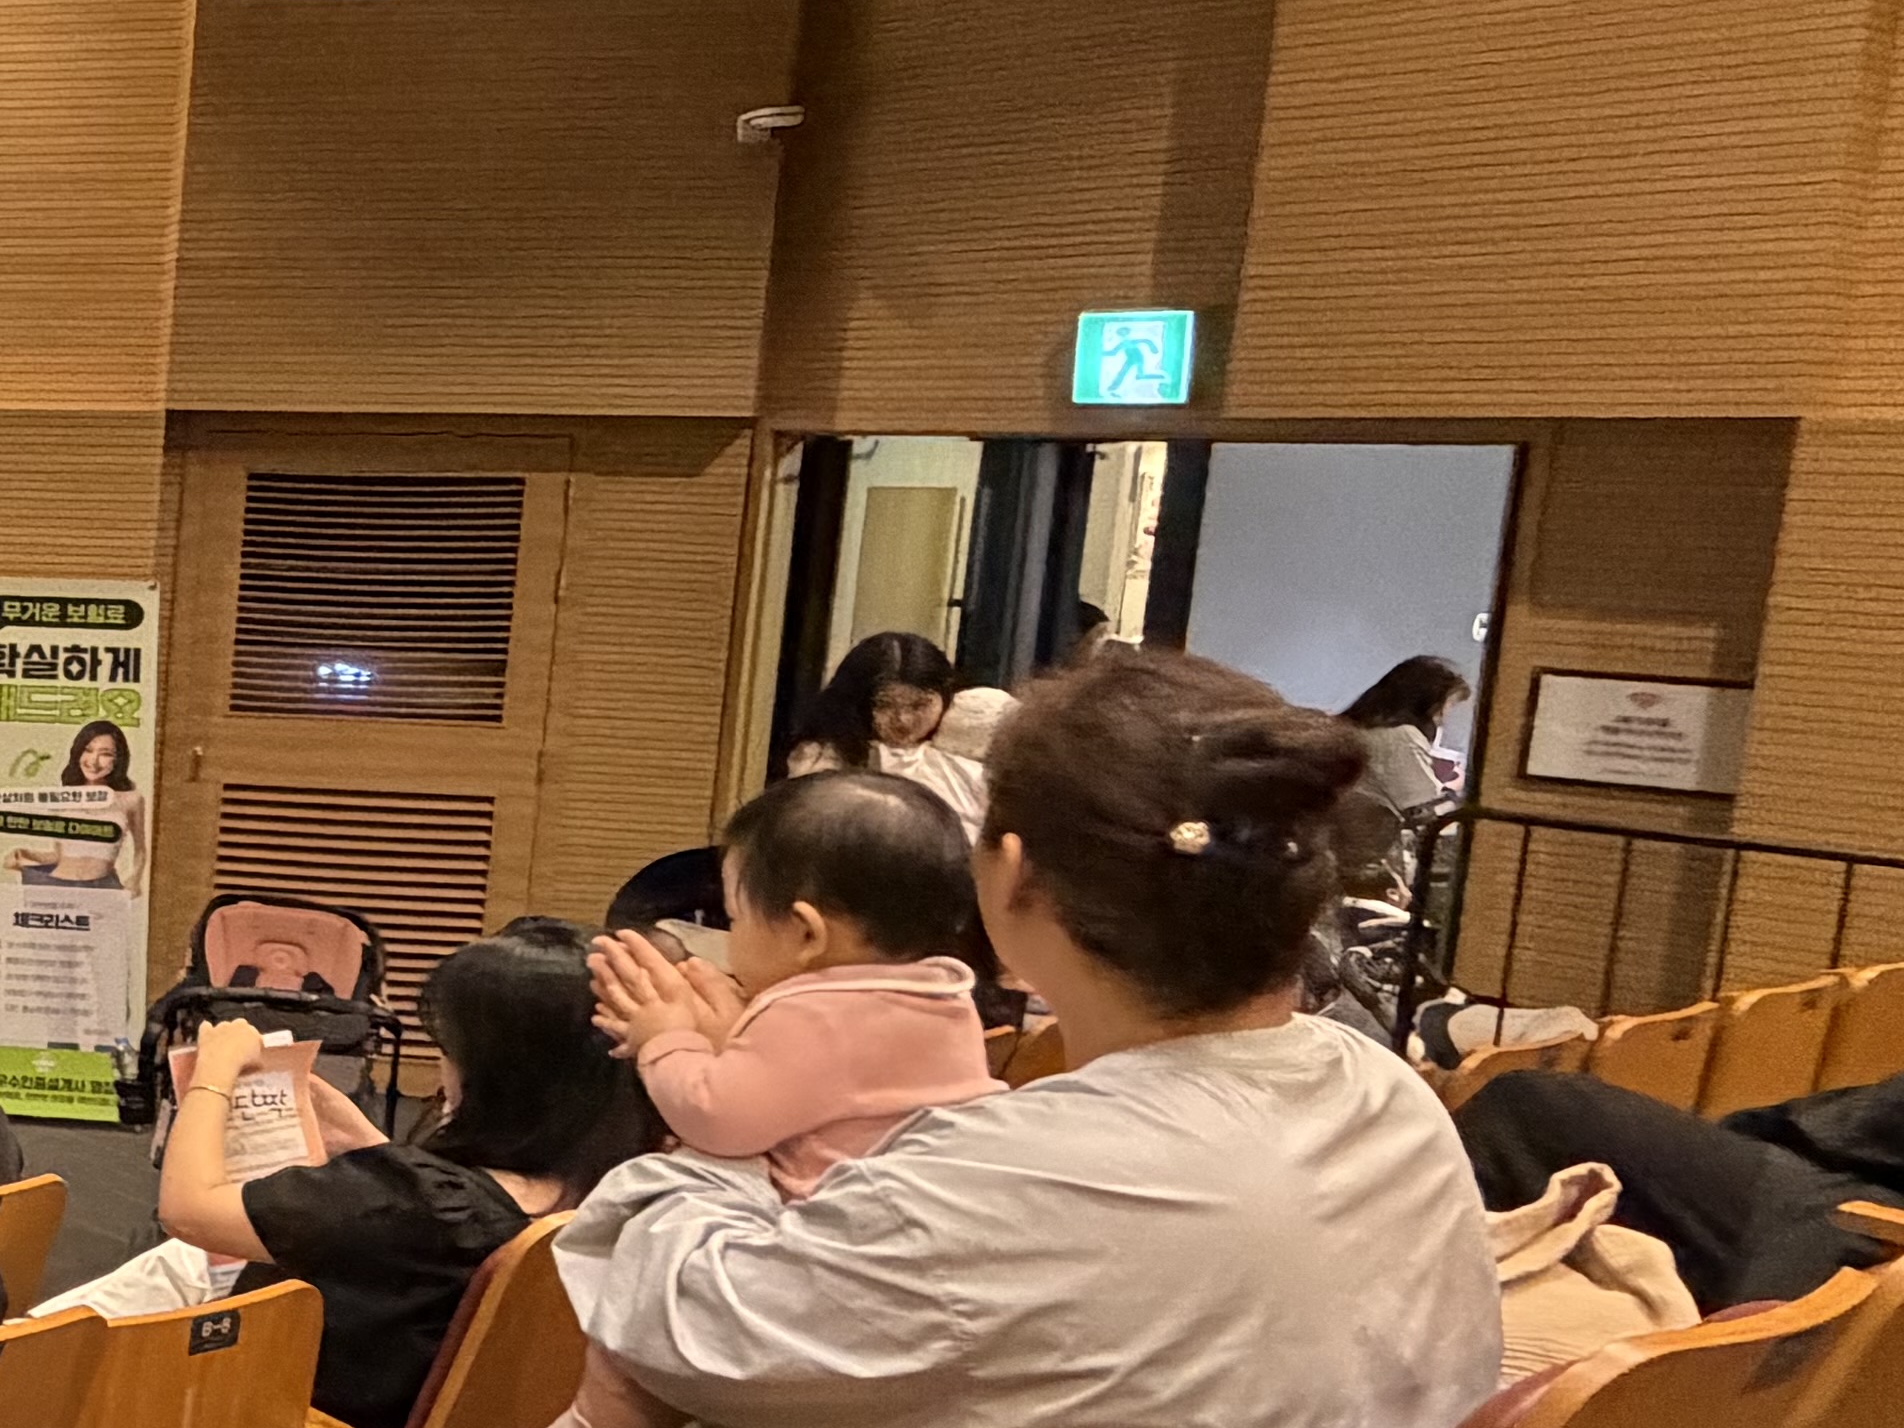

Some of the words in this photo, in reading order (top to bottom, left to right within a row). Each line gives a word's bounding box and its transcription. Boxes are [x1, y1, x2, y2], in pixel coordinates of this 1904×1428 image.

[2, 601, 61, 622] 무거운
[66, 603, 126, 624] 보험료
[13, 911, 90, 928] 체크리스트
